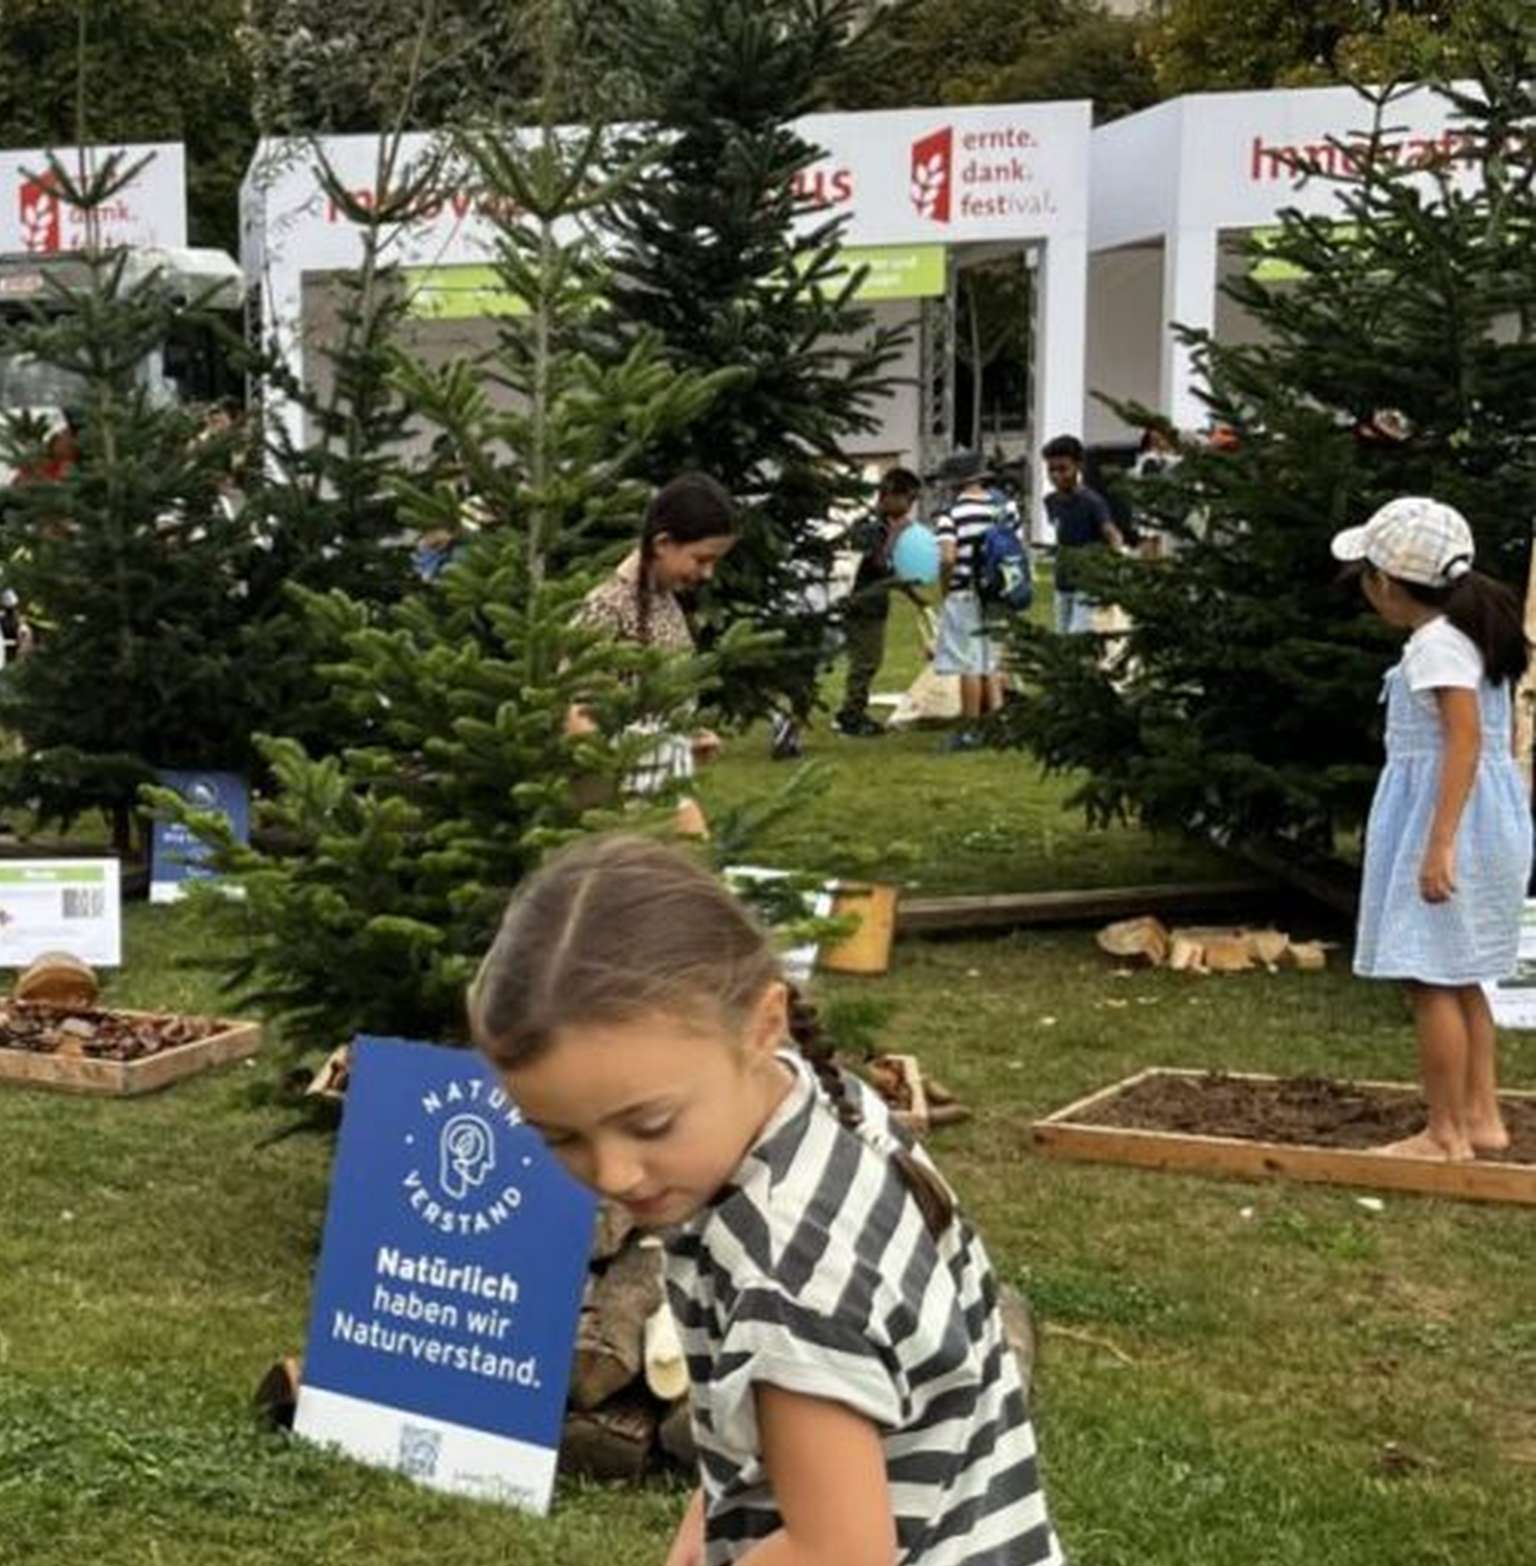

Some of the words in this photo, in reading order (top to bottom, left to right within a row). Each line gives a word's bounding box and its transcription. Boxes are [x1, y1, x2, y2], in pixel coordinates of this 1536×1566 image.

[961, 128, 1040, 150] ernte.
[961, 157, 1035, 184] dank.
[960, 189, 1059, 216] festival.
[403, 1170, 521, 1235] VERSTAND
[377, 1247, 519, 1303] Natürlich
[373, 1284, 458, 1327] haben
[467, 1308, 511, 1340] wir
[332, 1310, 542, 1390] Naturverstand.
